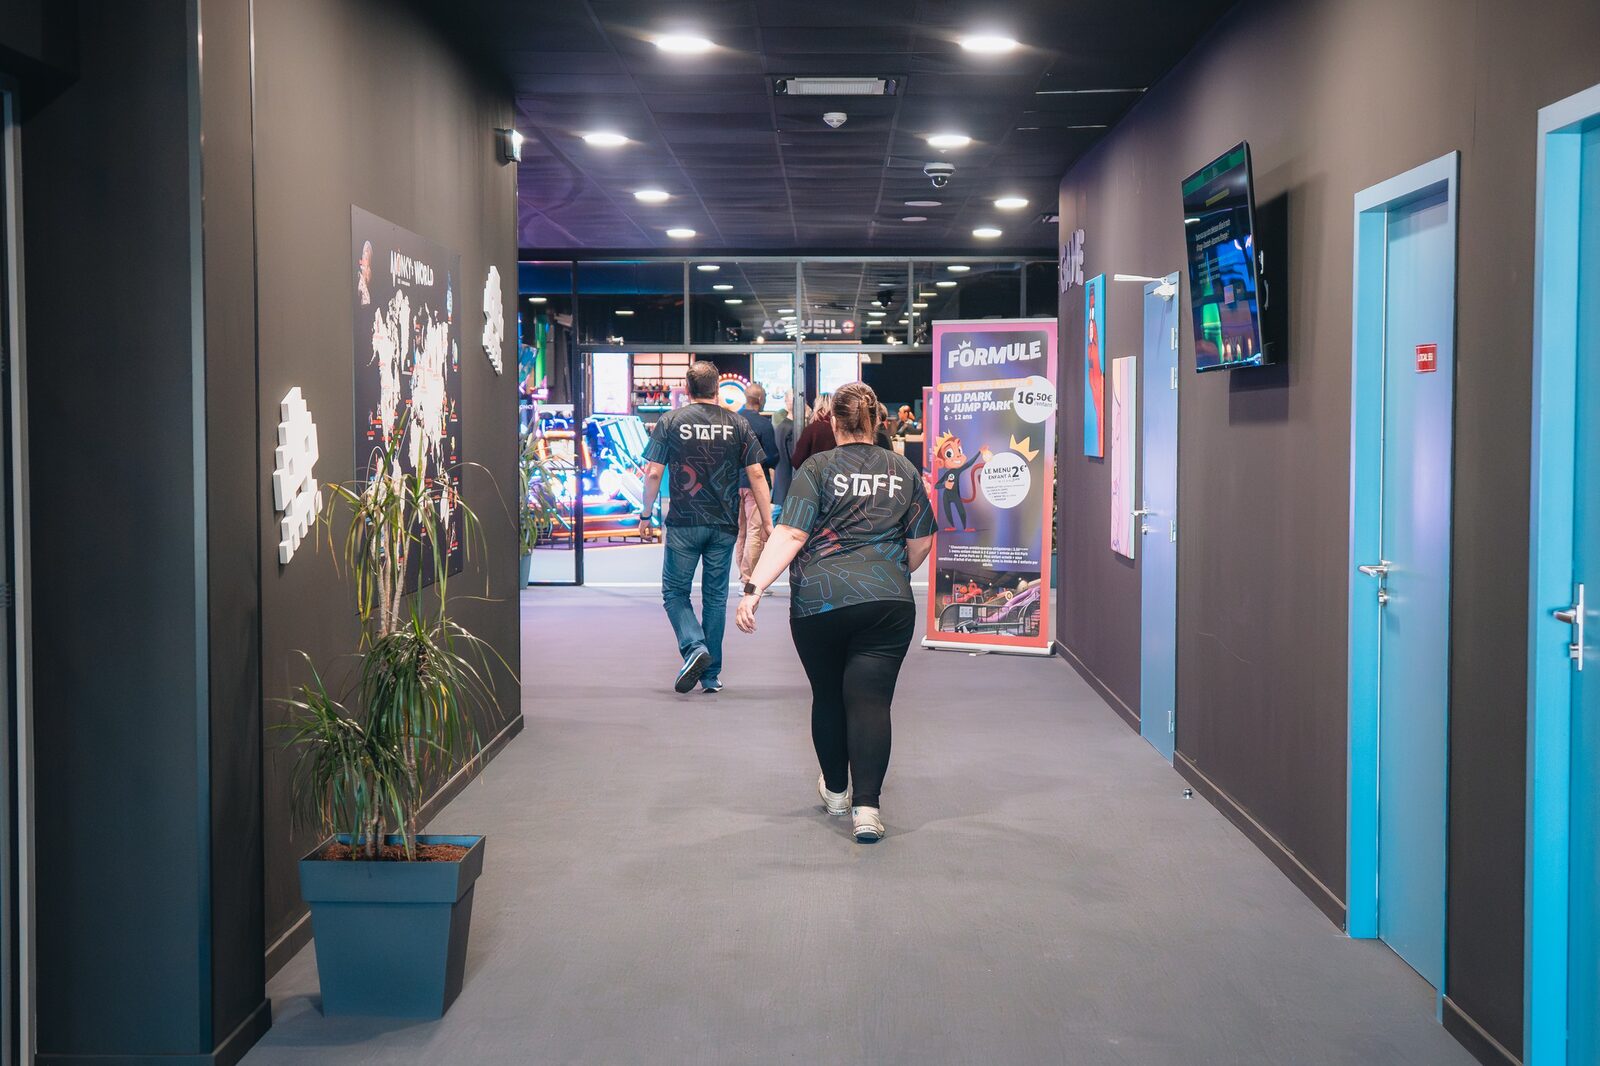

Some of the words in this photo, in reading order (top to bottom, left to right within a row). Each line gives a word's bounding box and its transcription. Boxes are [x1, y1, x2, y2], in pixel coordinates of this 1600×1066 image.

[414, 261, 434, 287] WORLD
[948, 341, 1041, 368] FORMULE
[943, 393, 962, 403] KID
[964, 391, 992, 402] PARK
[951, 402, 979, 413] JUMP
[679, 424, 734, 440] STAFF
[992, 466, 1012, 474] MENU
[833, 473, 904, 498] STAFF
